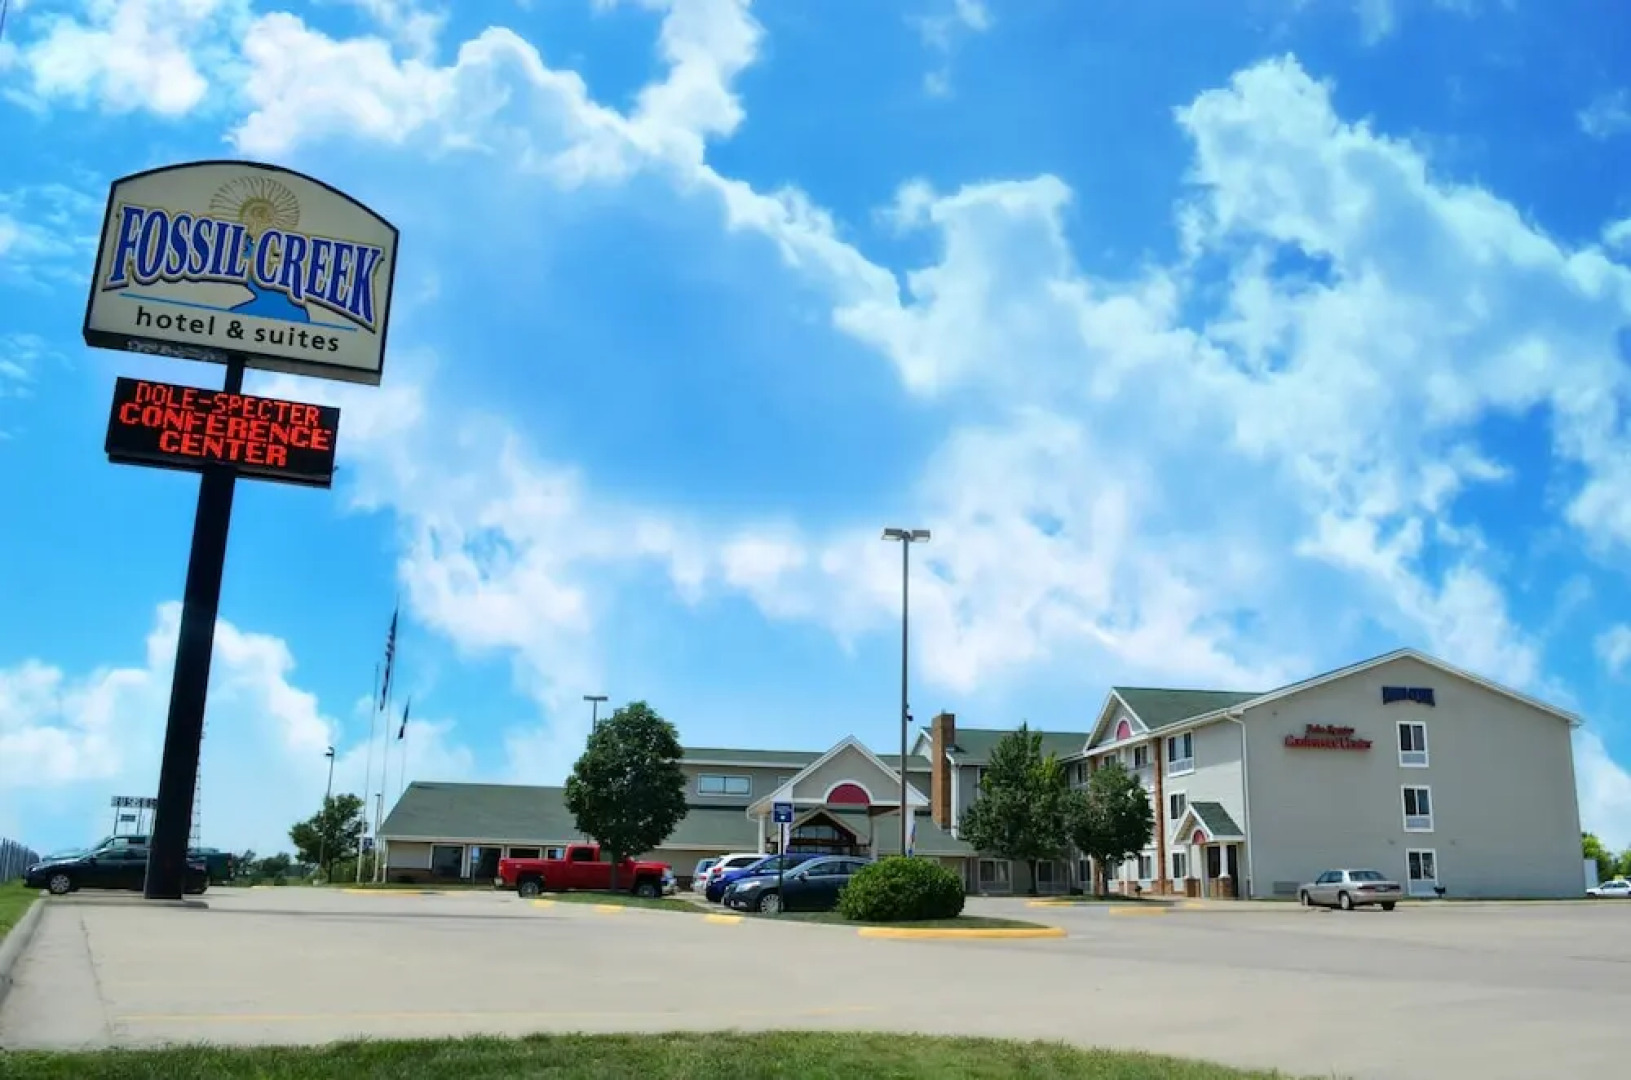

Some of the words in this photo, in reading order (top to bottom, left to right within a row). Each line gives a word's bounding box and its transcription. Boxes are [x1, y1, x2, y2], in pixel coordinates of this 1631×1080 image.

[106, 205, 249, 285] FOSSIL
[254, 228, 384, 325] CREEK
[136, 305, 215, 335] hotel
[226, 319, 244, 340] &
[254, 327, 339, 352] suites
[118, 403, 332, 450] CONFERENCE
[159, 430, 288, 467] CENTER
